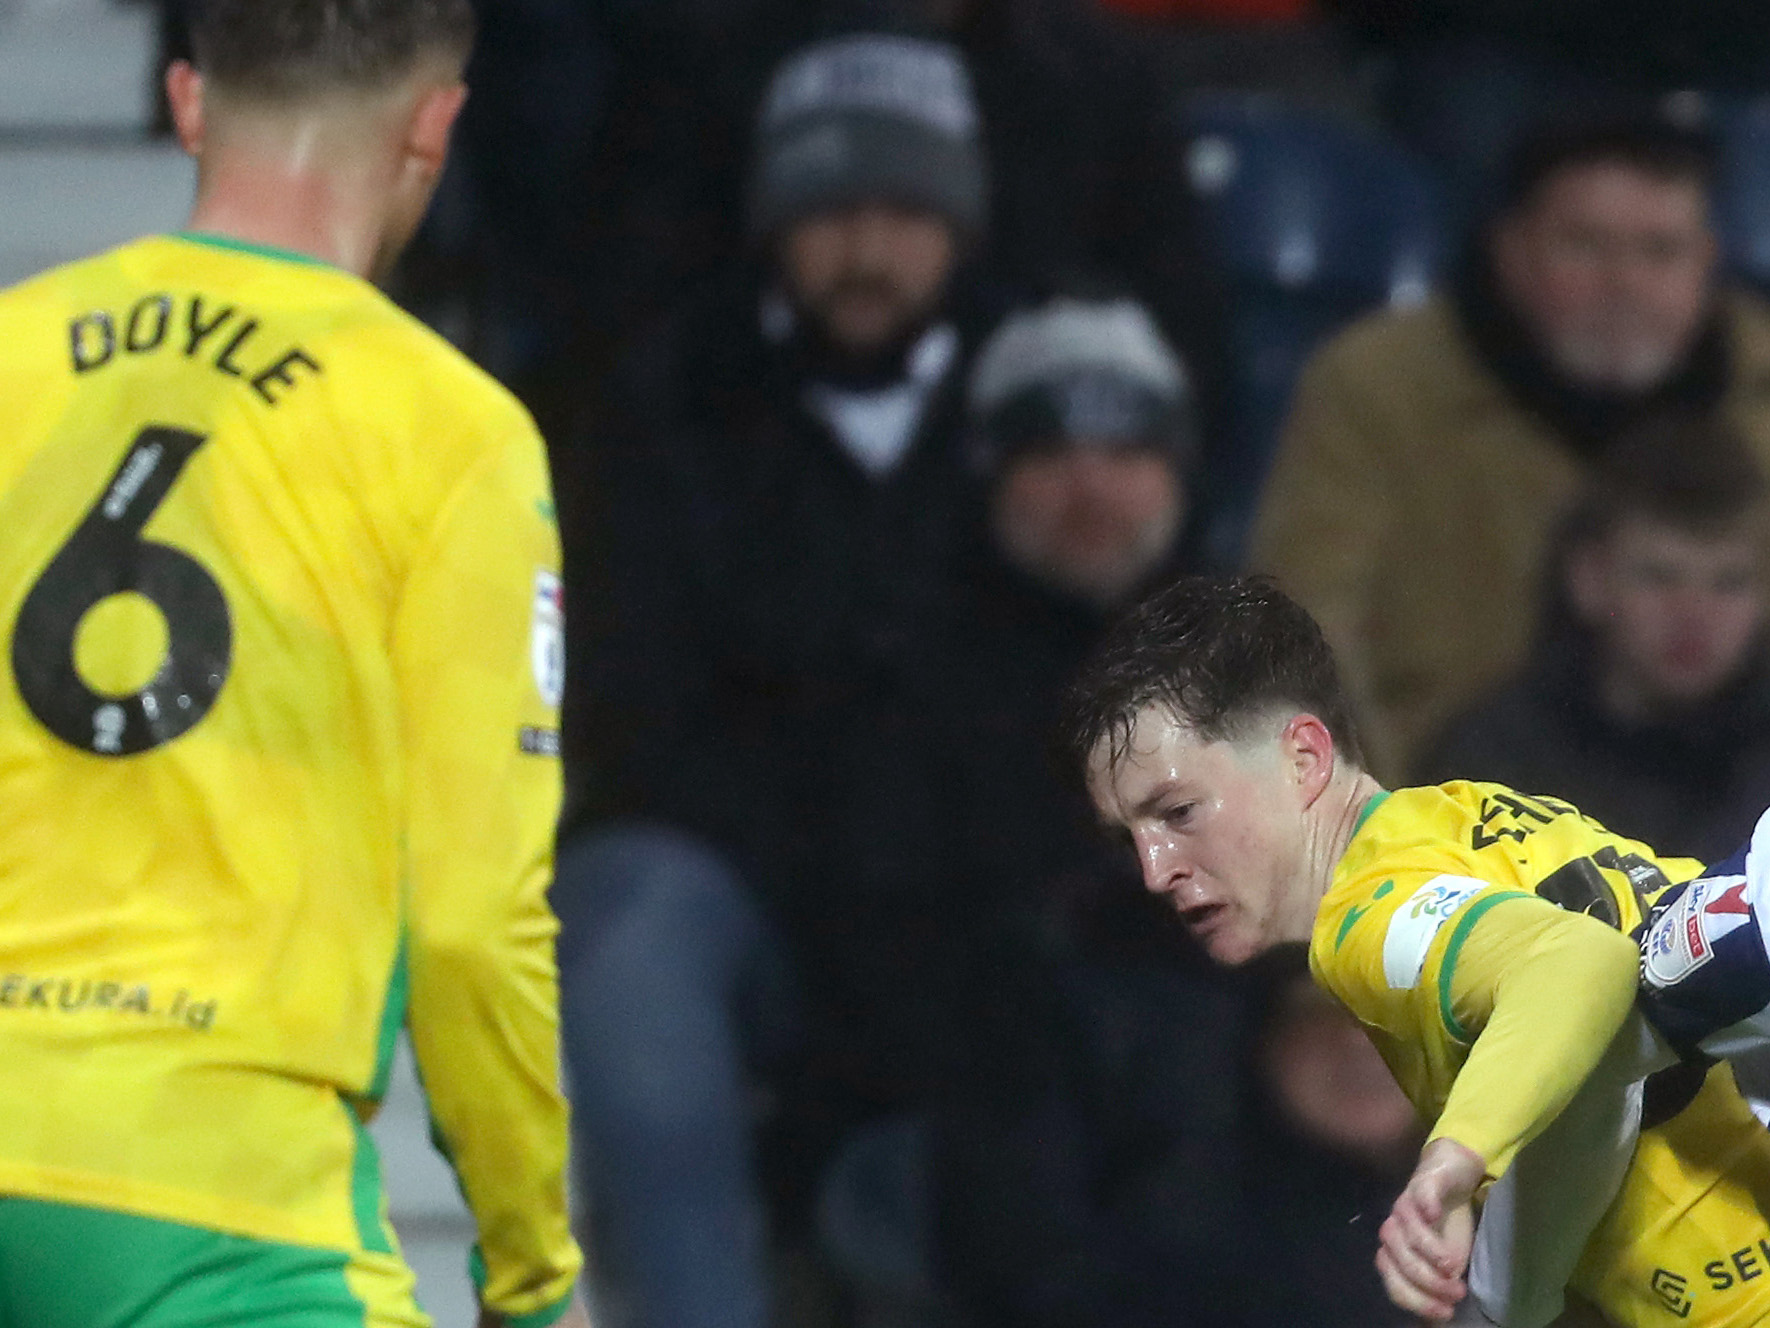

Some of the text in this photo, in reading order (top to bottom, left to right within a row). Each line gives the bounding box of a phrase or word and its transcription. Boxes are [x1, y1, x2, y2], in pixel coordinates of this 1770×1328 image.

[68, 292, 324, 407] DOYLE
[10, 421, 233, 759] 6
[0, 973, 218, 1032] EKURA.id
